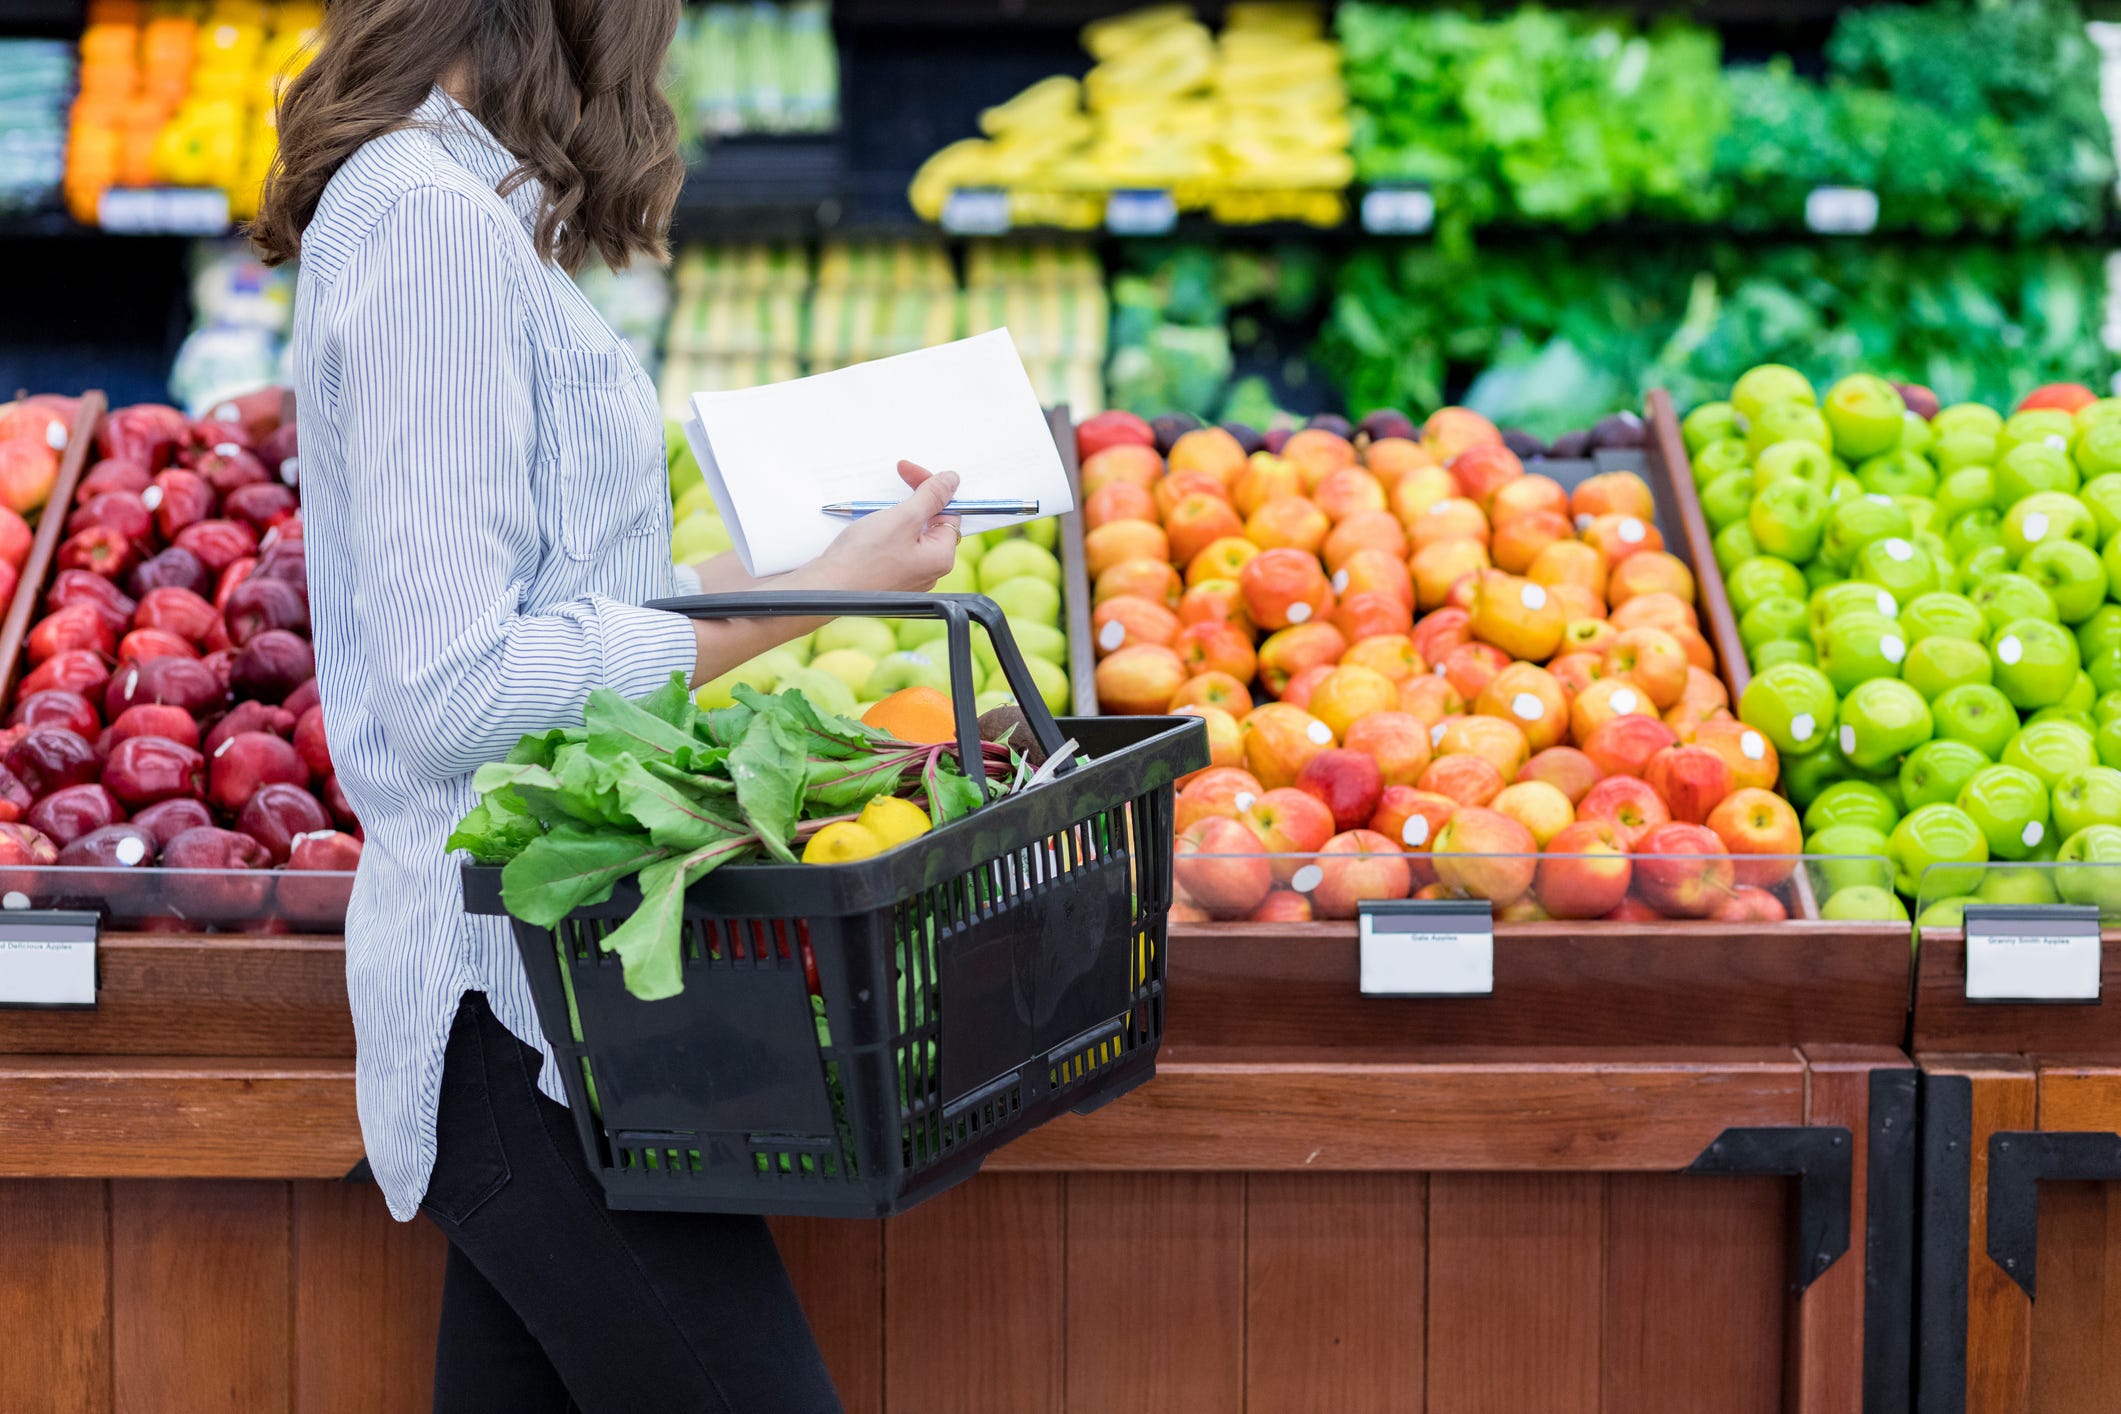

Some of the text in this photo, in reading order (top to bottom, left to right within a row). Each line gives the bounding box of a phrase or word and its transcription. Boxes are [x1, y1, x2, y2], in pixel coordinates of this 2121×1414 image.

[1432, 934, 1457, 942] Apples
[1988, 936, 2070, 945] Granny Smith Apples
[47, 942, 72, 951] Apples
